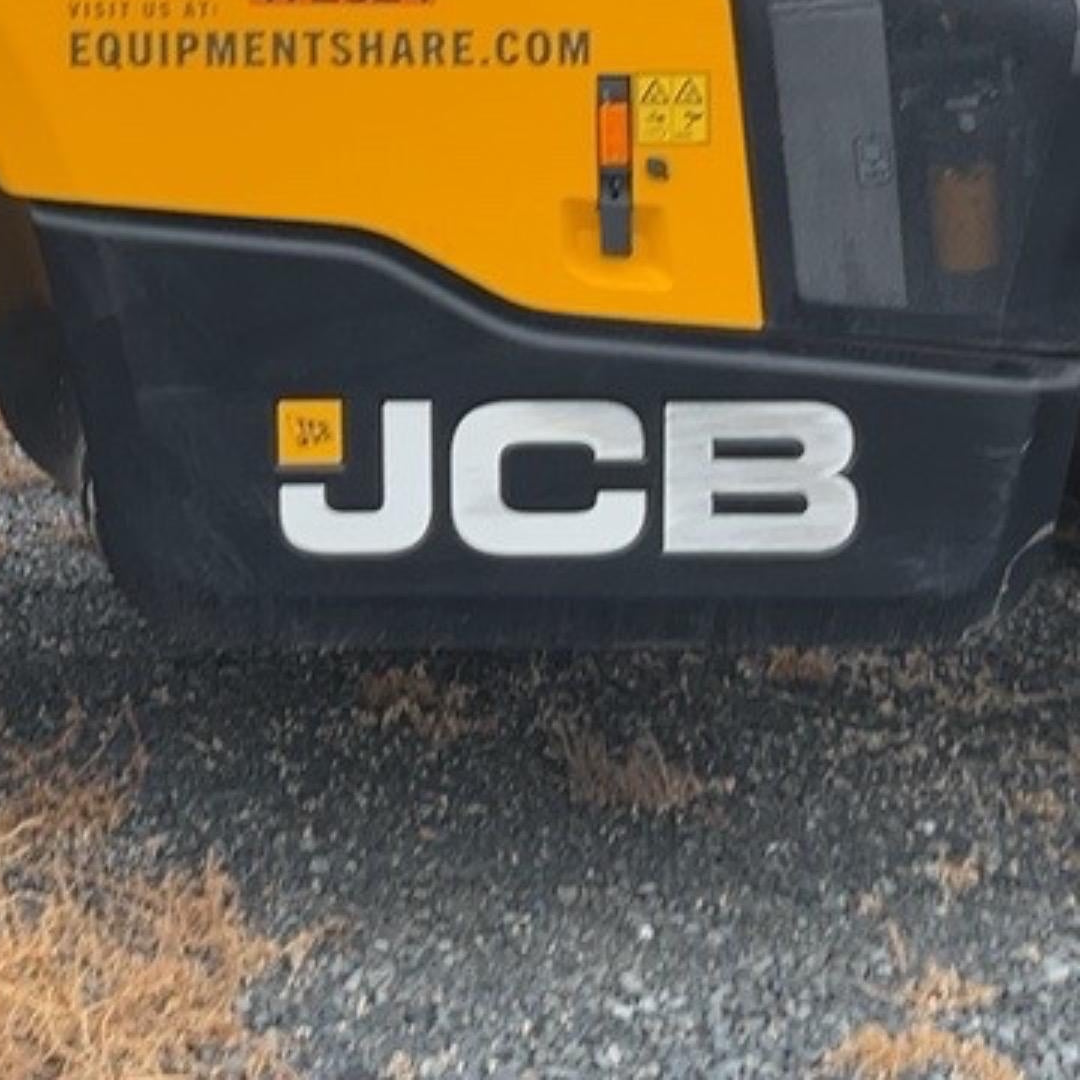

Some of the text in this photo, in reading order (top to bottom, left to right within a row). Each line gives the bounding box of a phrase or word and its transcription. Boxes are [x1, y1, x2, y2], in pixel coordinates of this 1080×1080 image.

[69, 0, 131, 19] VISIT
[142, 0, 171, 19] US
[70, 29, 591, 69] EQUIPMENTSHARE.COM
[277, 398, 859, 556] JCB
